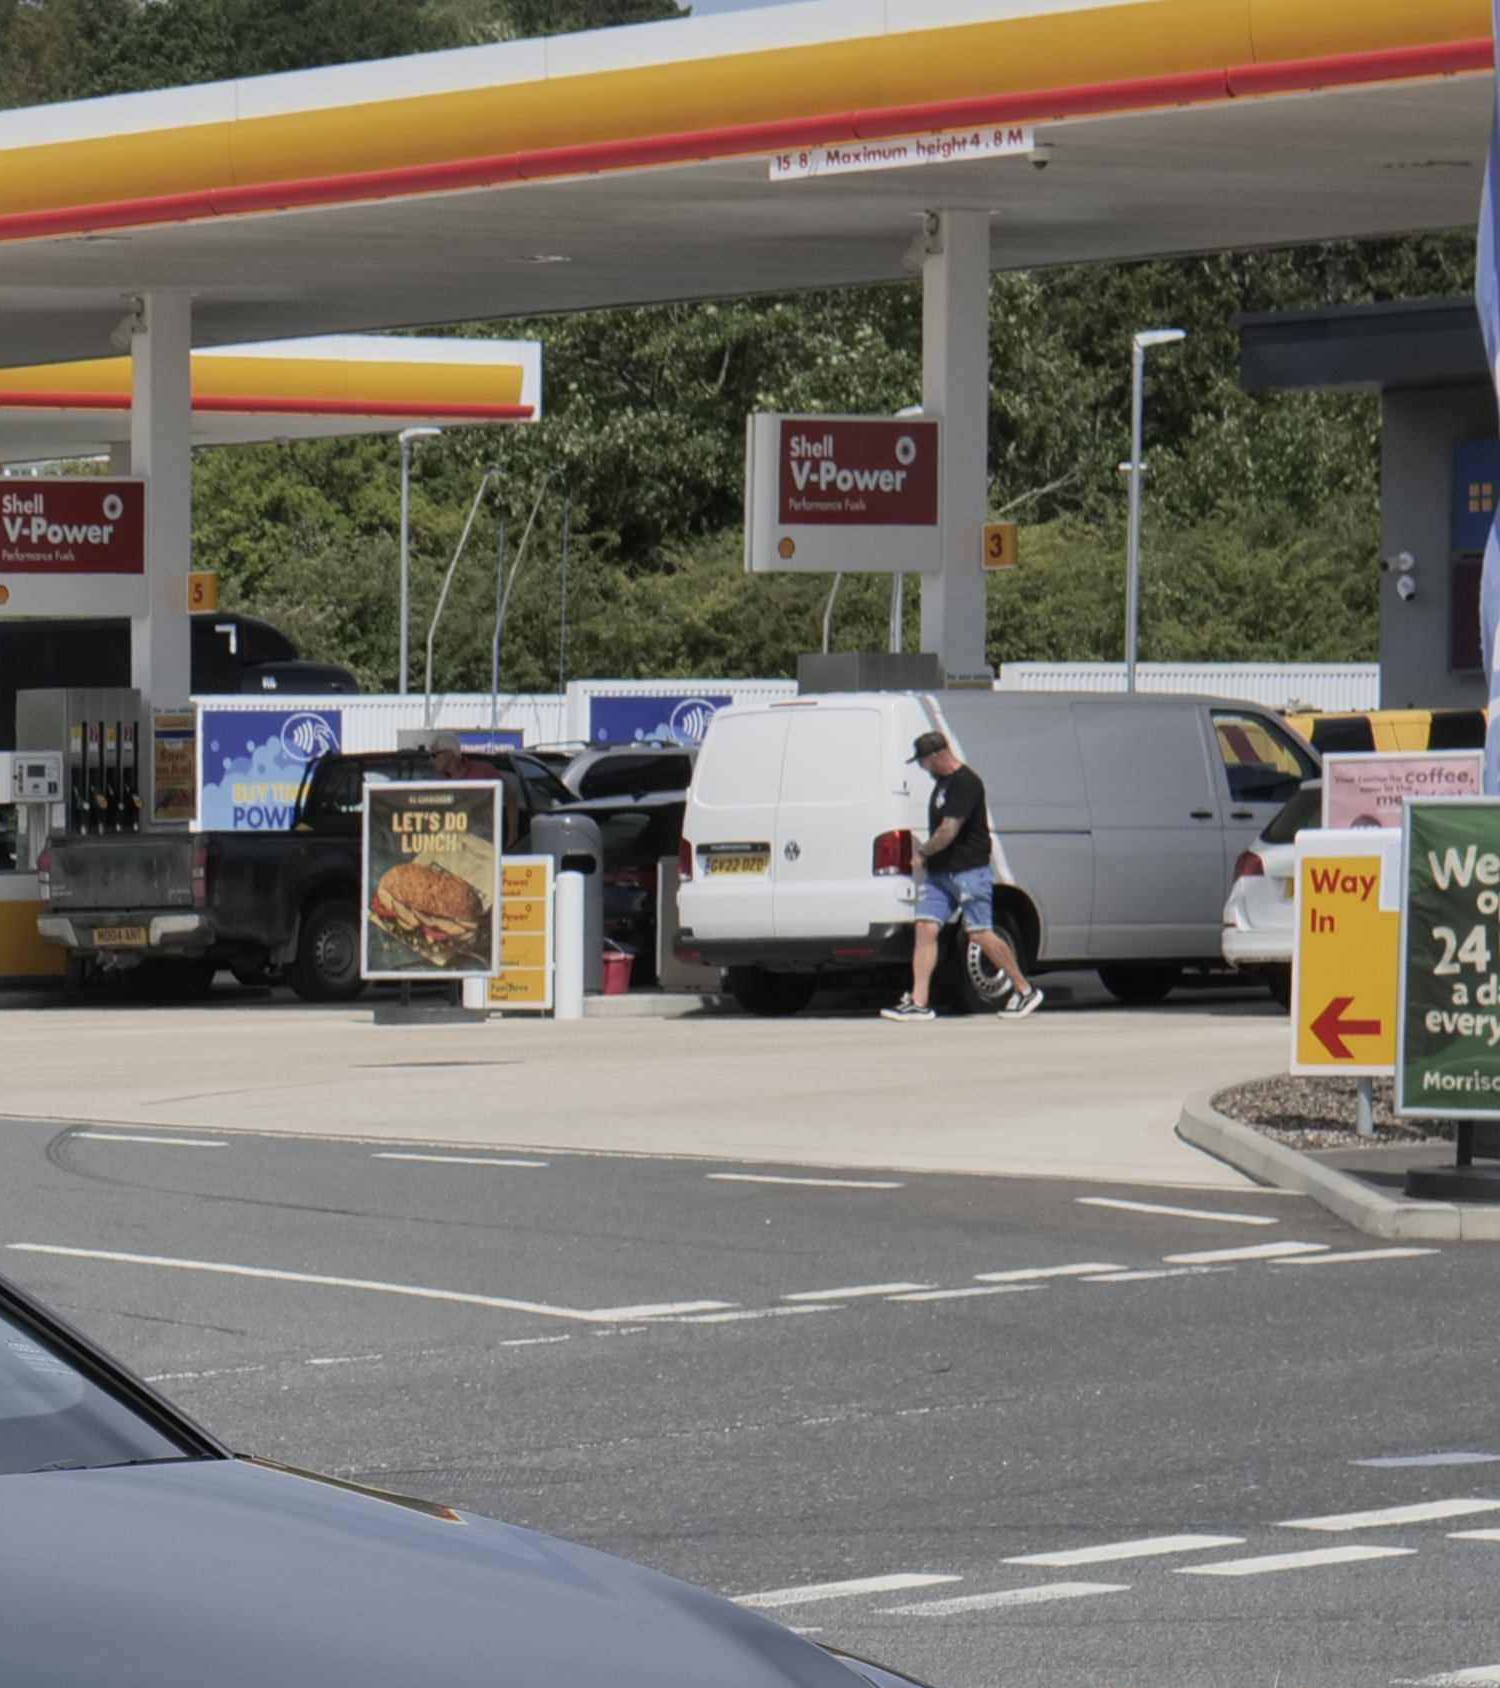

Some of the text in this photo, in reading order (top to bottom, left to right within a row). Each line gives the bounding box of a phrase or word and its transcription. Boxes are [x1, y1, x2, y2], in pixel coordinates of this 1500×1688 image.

[826, 147, 907, 167] Maximum
[916, 137, 967, 159] height
[789, 435, 834, 459] Shell
[789, 460, 907, 493] V-Power
[2, 493, 44, 514] Shell
[788, 497, 866, 511] Performance Fuels
[2, 517, 113, 544] V-Power
[1, 549, 75, 561] Performance Fuels
[989, 533, 1003, 558] 3
[193, 583, 203, 602] 5
[1404, 767, 1475, 786] coffee,
[233, 783, 268, 803] BUY
[232, 806, 297, 829] POWE
[391, 811, 468, 832] LET'S DO
[401, 833, 458, 853] LUNCH
[1310, 867, 1377, 902] Way
[1311, 907, 1335, 933] In
[1432, 925, 1491, 976] 24
[1452, 982, 1470, 1006] a
